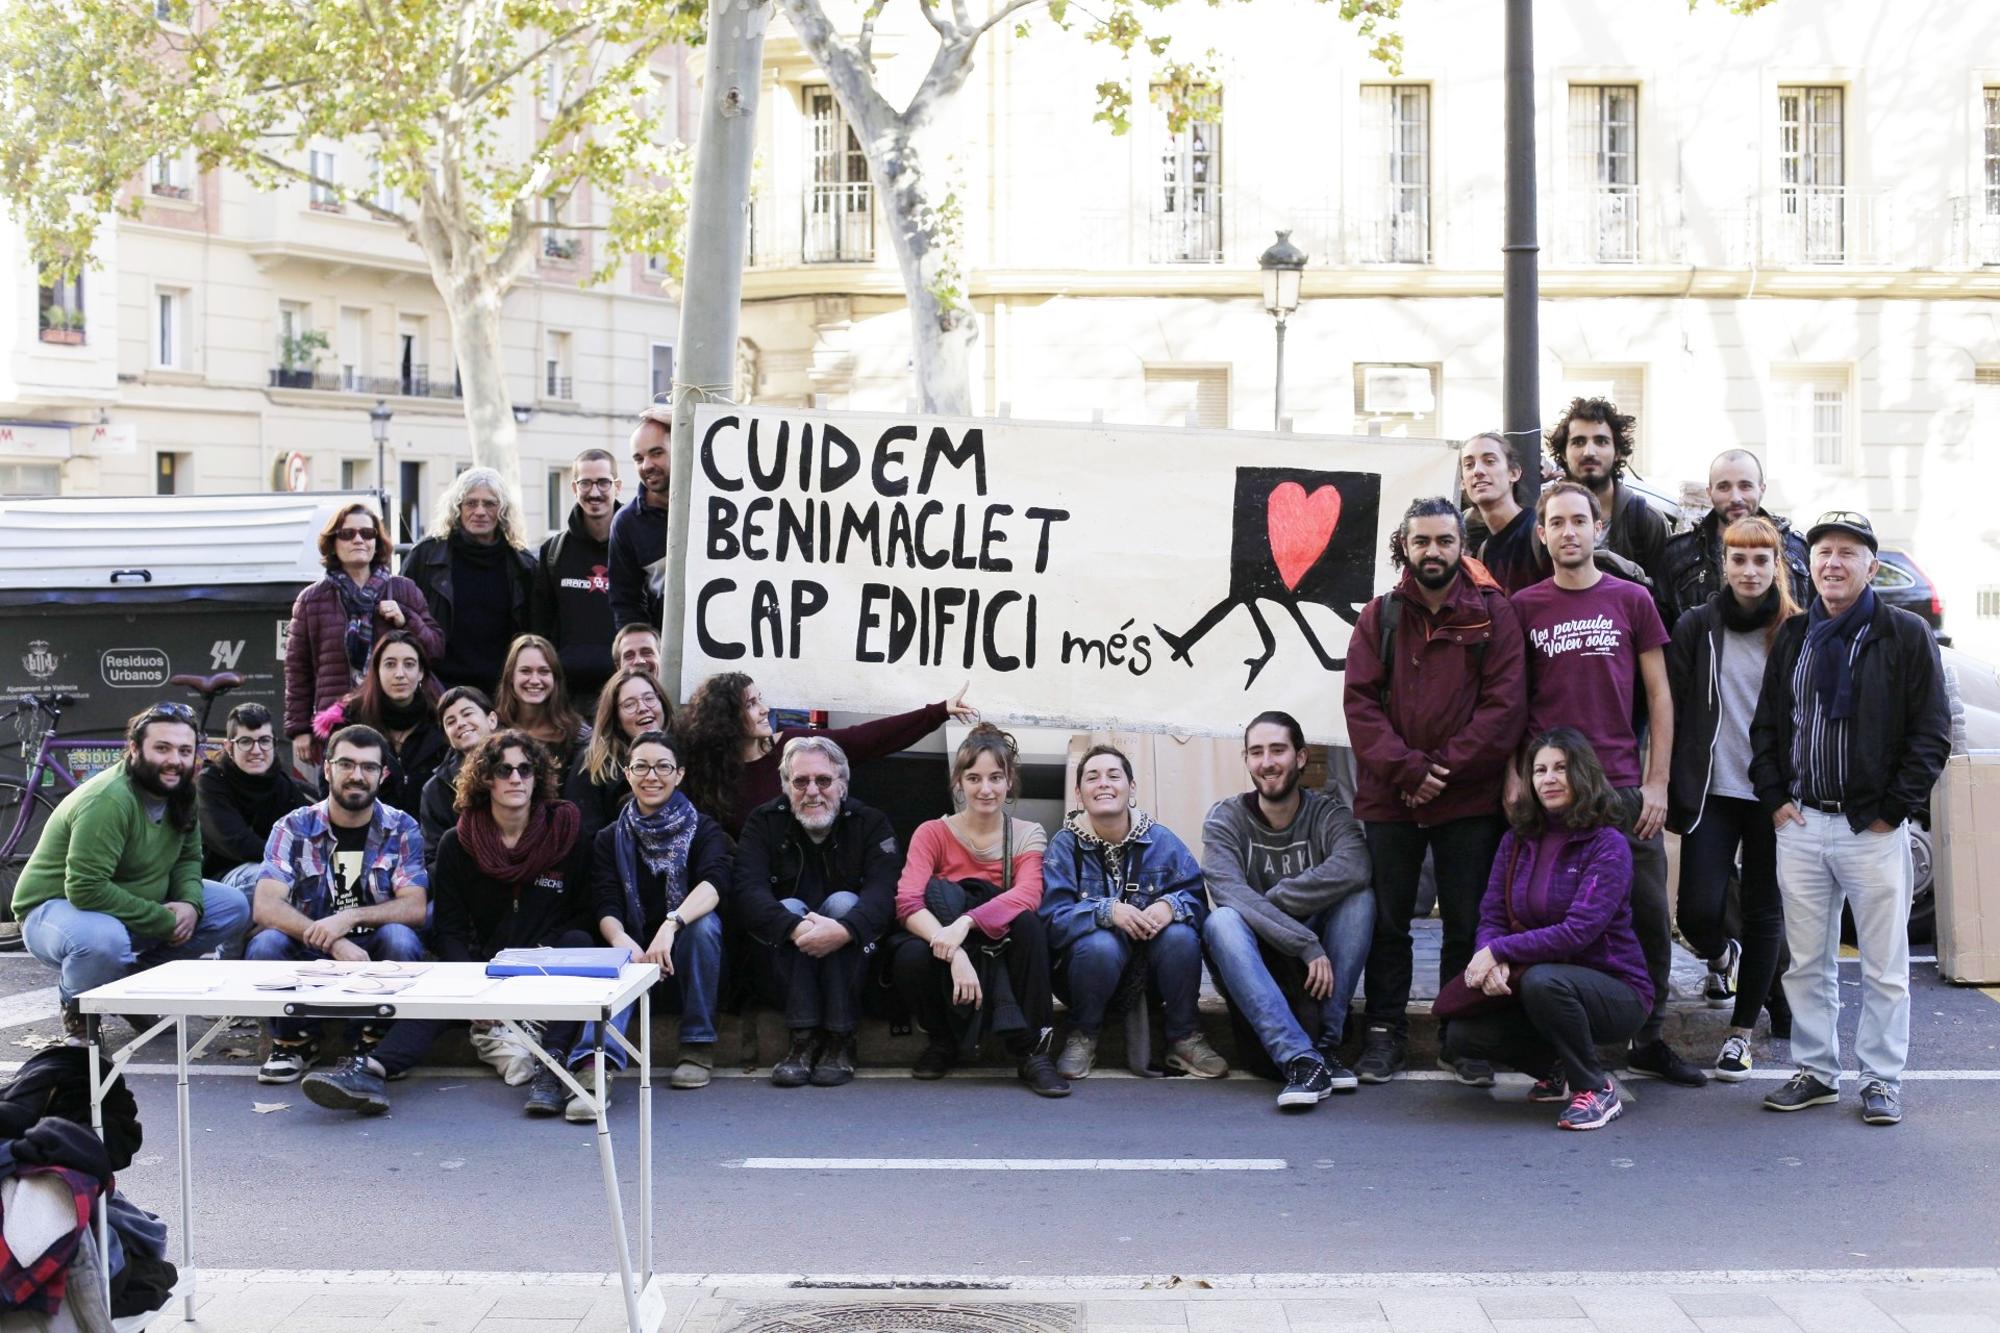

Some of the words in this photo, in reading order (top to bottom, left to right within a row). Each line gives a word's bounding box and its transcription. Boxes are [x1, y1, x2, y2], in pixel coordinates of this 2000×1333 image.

[700, 416, 988, 497] CUIDEM
[706, 496, 1070, 574] BENIMACLET
[697, 578, 829, 661] CAP
[855, 581, 1037, 673] EDIFICI
[1061, 617, 1153, 677] més
[1530, 628, 1549, 648] Les
[1553, 614, 1613, 640] paraules
[106, 655, 164, 668] Residuos
[110, 669, 162, 681] Urbanos
